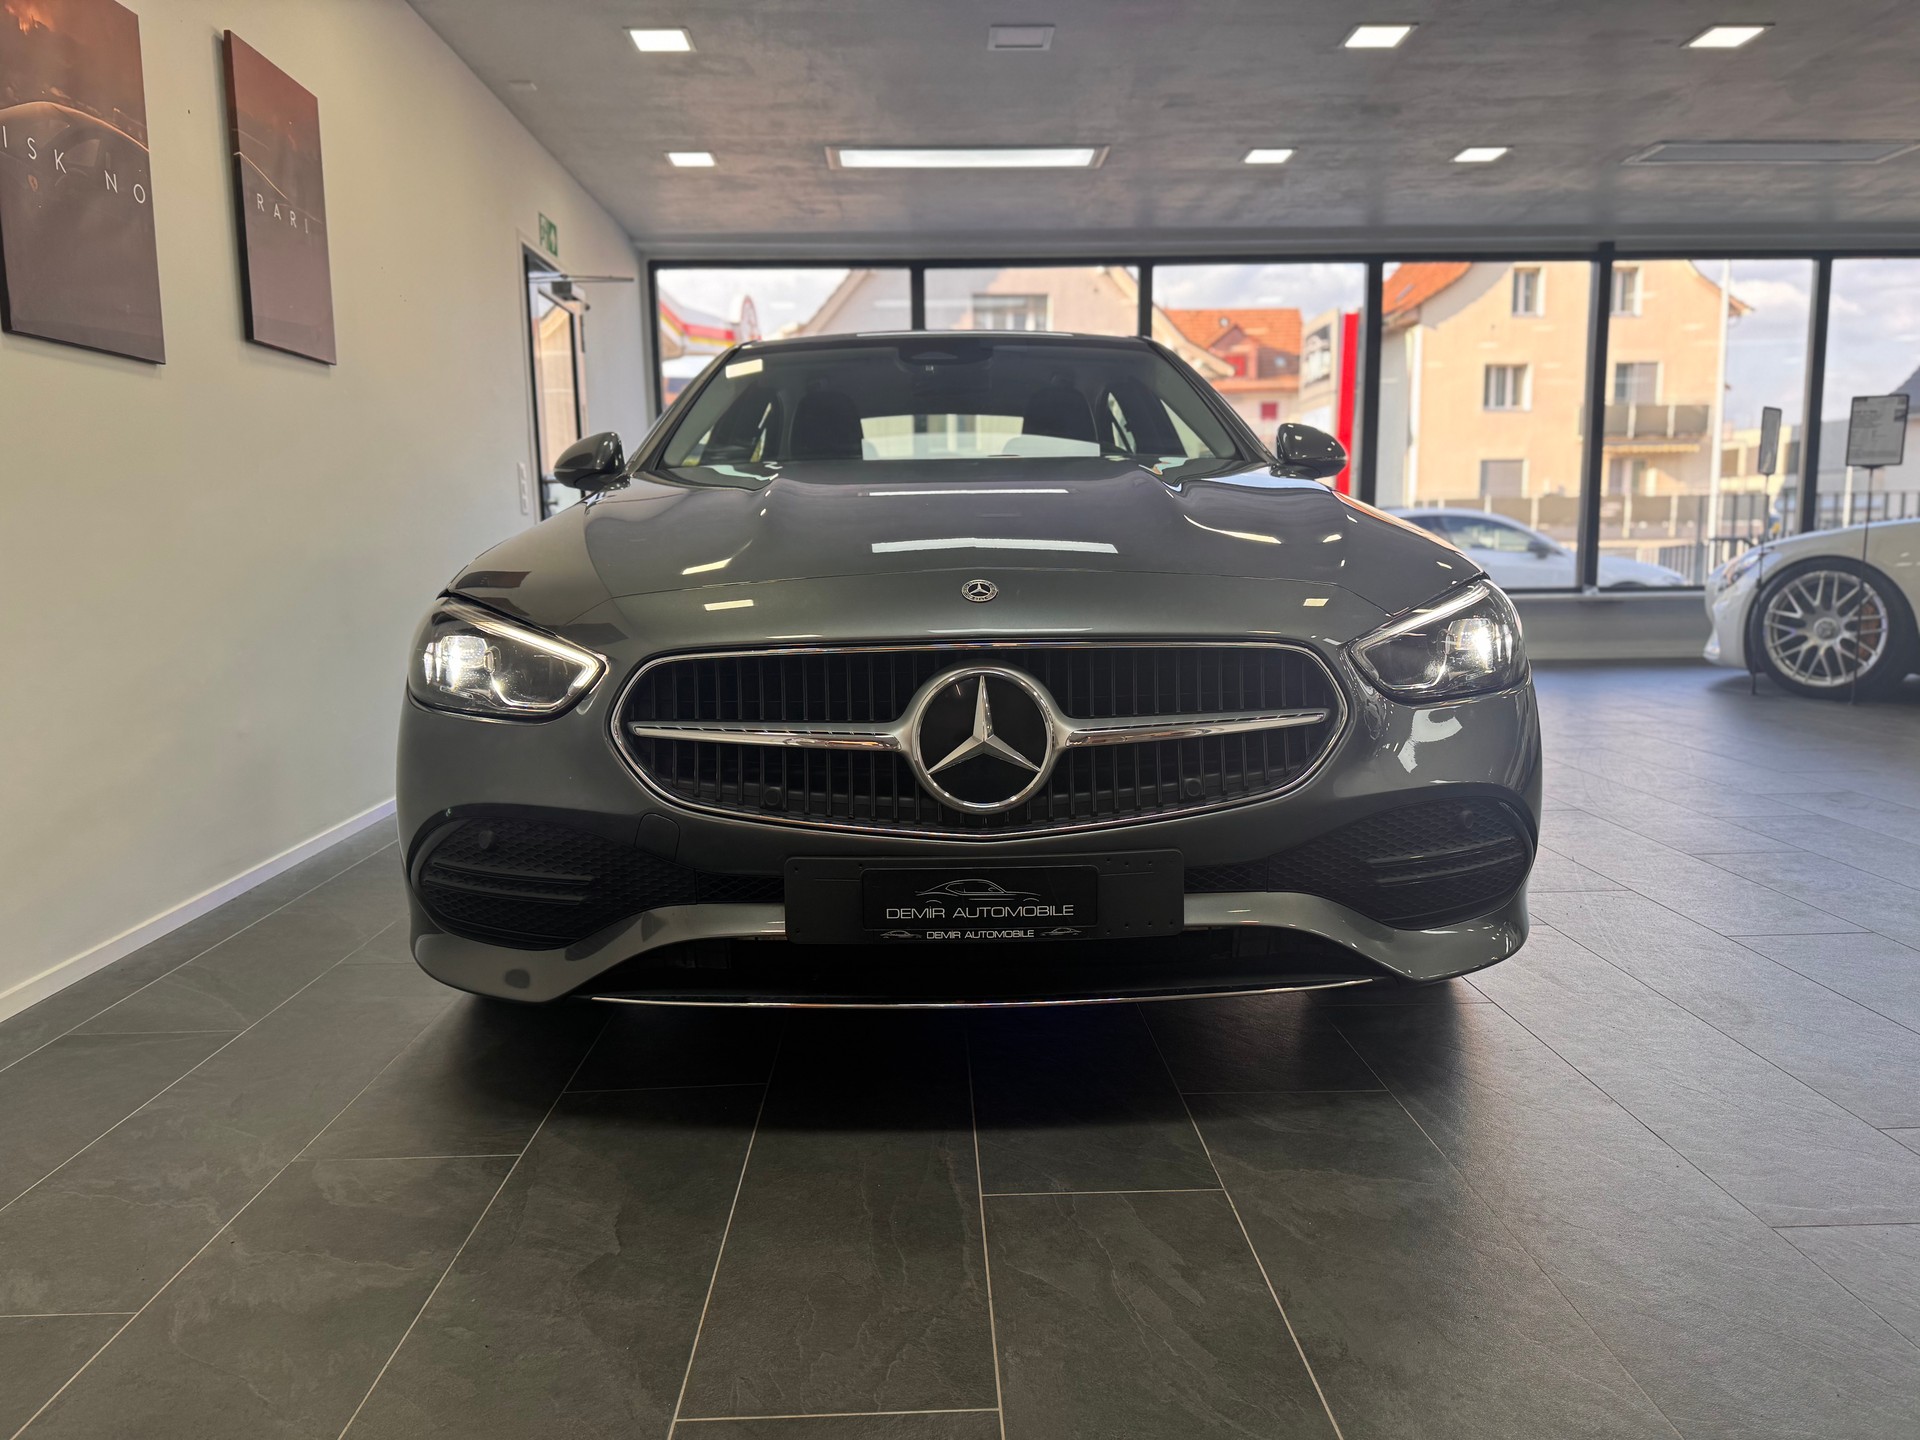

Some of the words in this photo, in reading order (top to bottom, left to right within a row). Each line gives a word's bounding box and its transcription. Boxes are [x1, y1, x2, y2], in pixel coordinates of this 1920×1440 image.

[104, 169, 146, 204] NO
[256, 193, 309, 234] RARI
[952, 904, 1075, 919] AUTOMOBILE
[964, 929, 1035, 939] AUTOMOBILE
